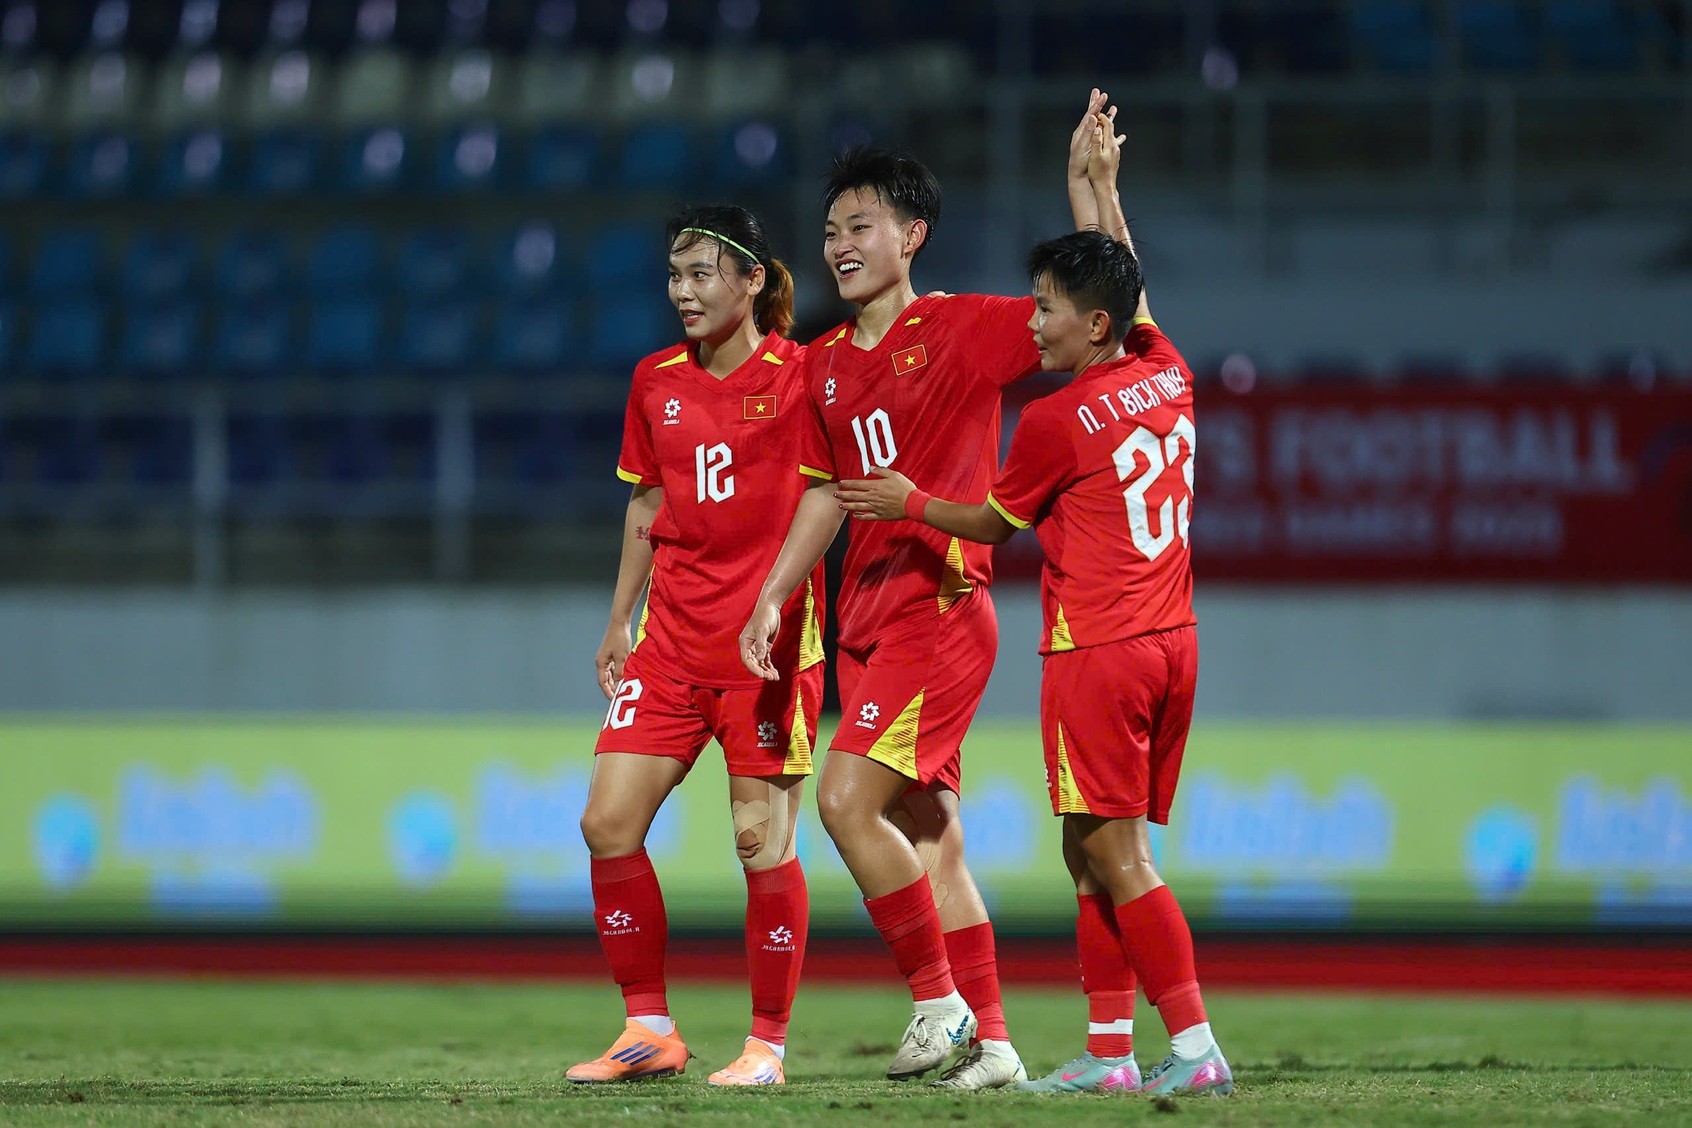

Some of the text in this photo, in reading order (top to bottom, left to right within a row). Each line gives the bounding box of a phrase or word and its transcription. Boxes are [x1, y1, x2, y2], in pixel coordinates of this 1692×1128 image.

[695, 441, 735, 504] 12
[850, 407, 899, 477] 10
[601, 677, 644, 732] 12
